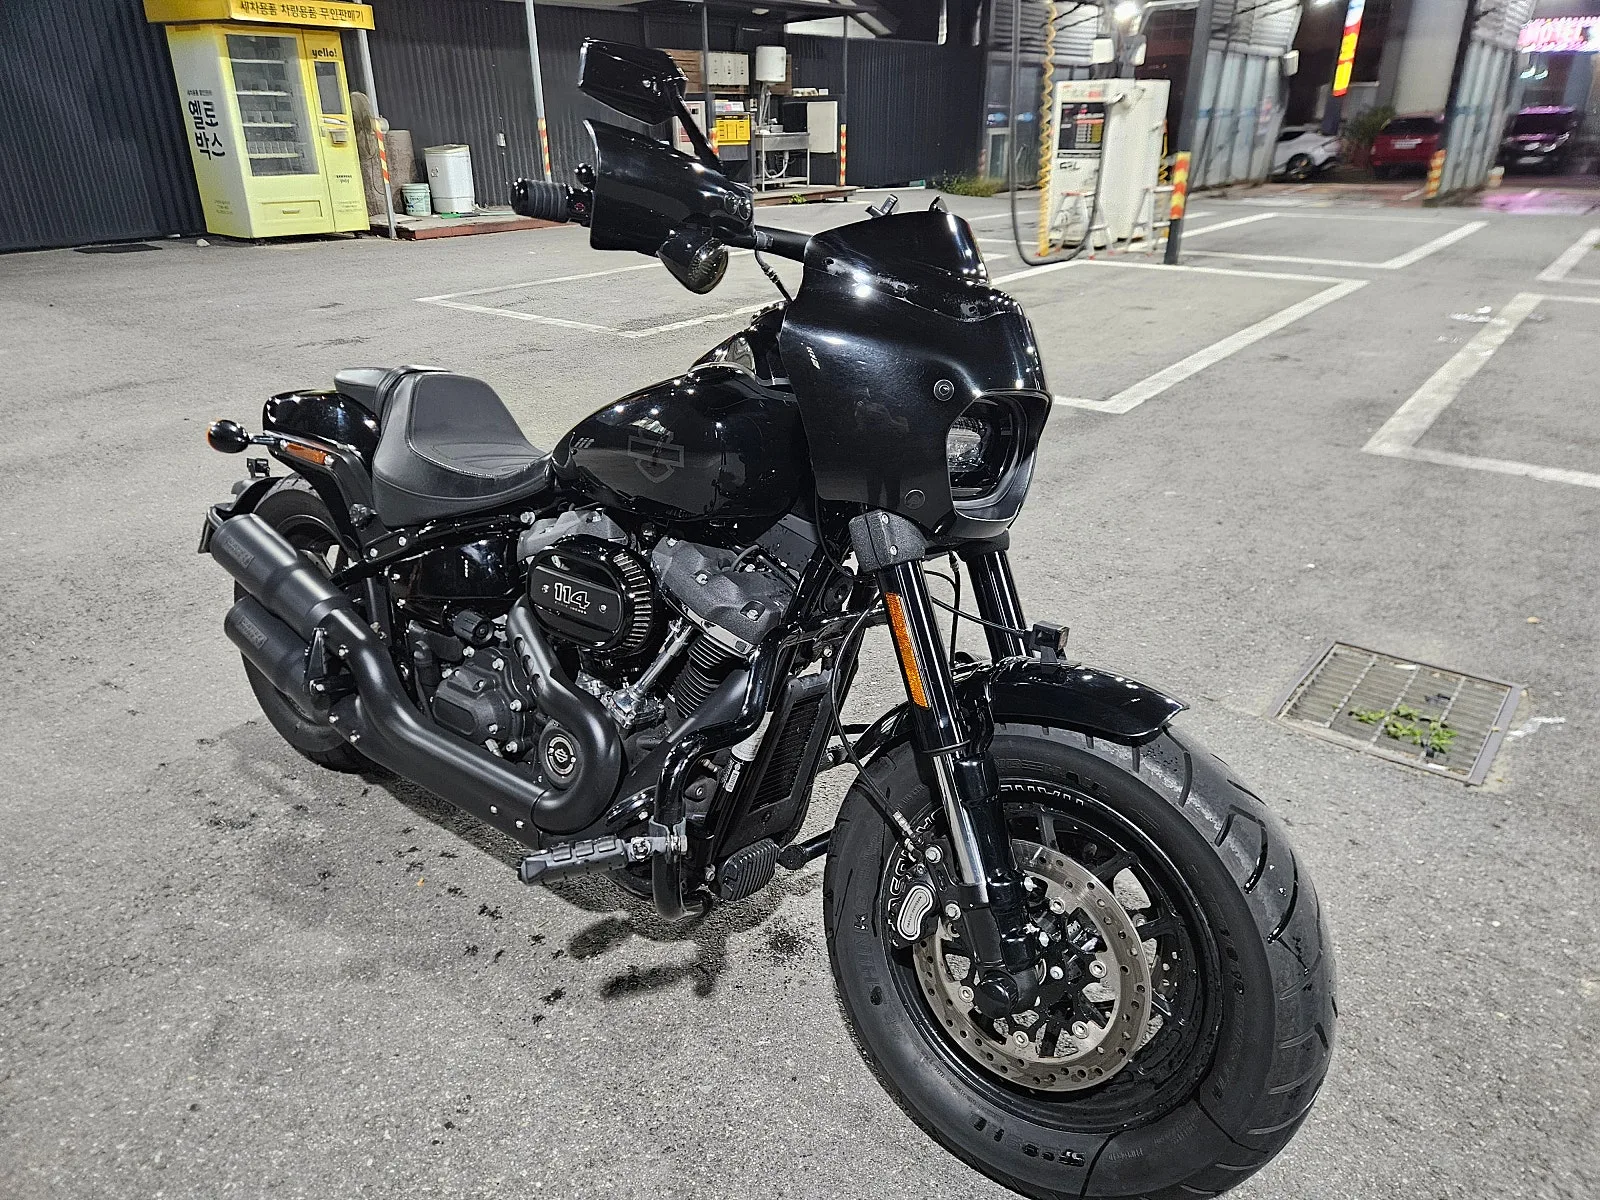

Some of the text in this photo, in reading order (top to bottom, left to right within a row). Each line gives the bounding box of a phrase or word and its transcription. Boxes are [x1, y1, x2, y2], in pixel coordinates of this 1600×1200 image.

[240, 1, 364, 23] 세차용품 차량용품 무인판매기
[312, 47, 338, 59] yello!
[194, 131, 226, 161] 박스
[554, 582, 591, 610] 114
